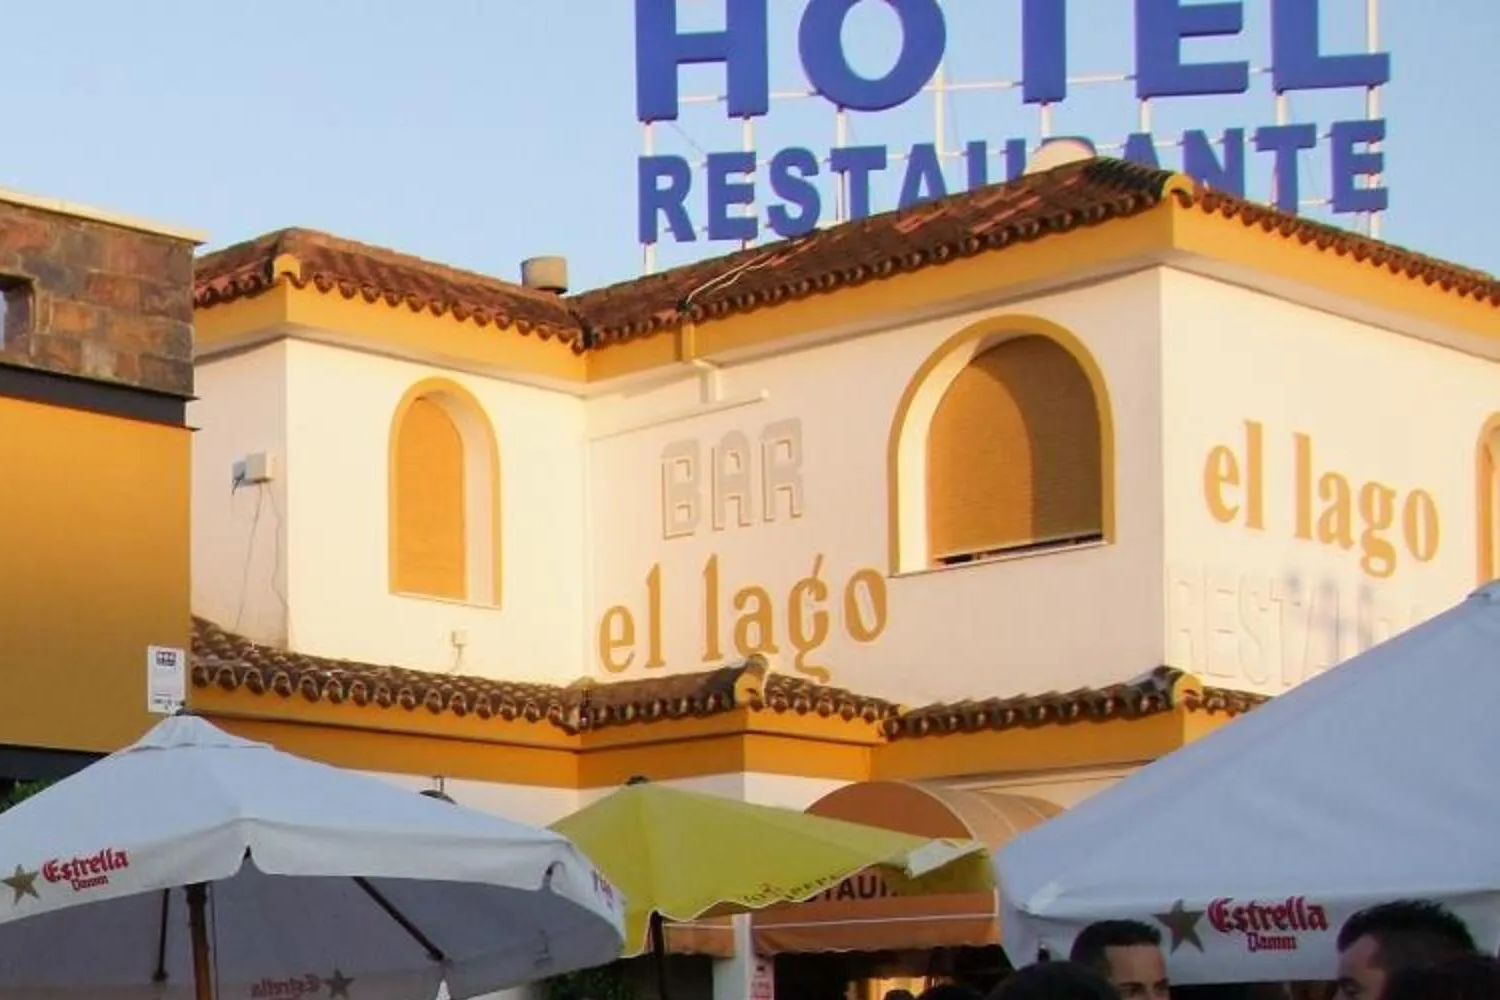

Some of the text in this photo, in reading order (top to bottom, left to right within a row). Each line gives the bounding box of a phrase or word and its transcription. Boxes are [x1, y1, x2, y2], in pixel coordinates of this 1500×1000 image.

[638, 118, 1388, 243] RESTAUNTE
[660, 416, 803, 540] BAR
[1202, 417, 1440, 579] el lago
[600, 553, 888, 683] el lago
[42, 847, 129, 883] Estrella
[1207, 896, 1329, 933] Estrella
[1246, 931, 1298, 952] Damm
